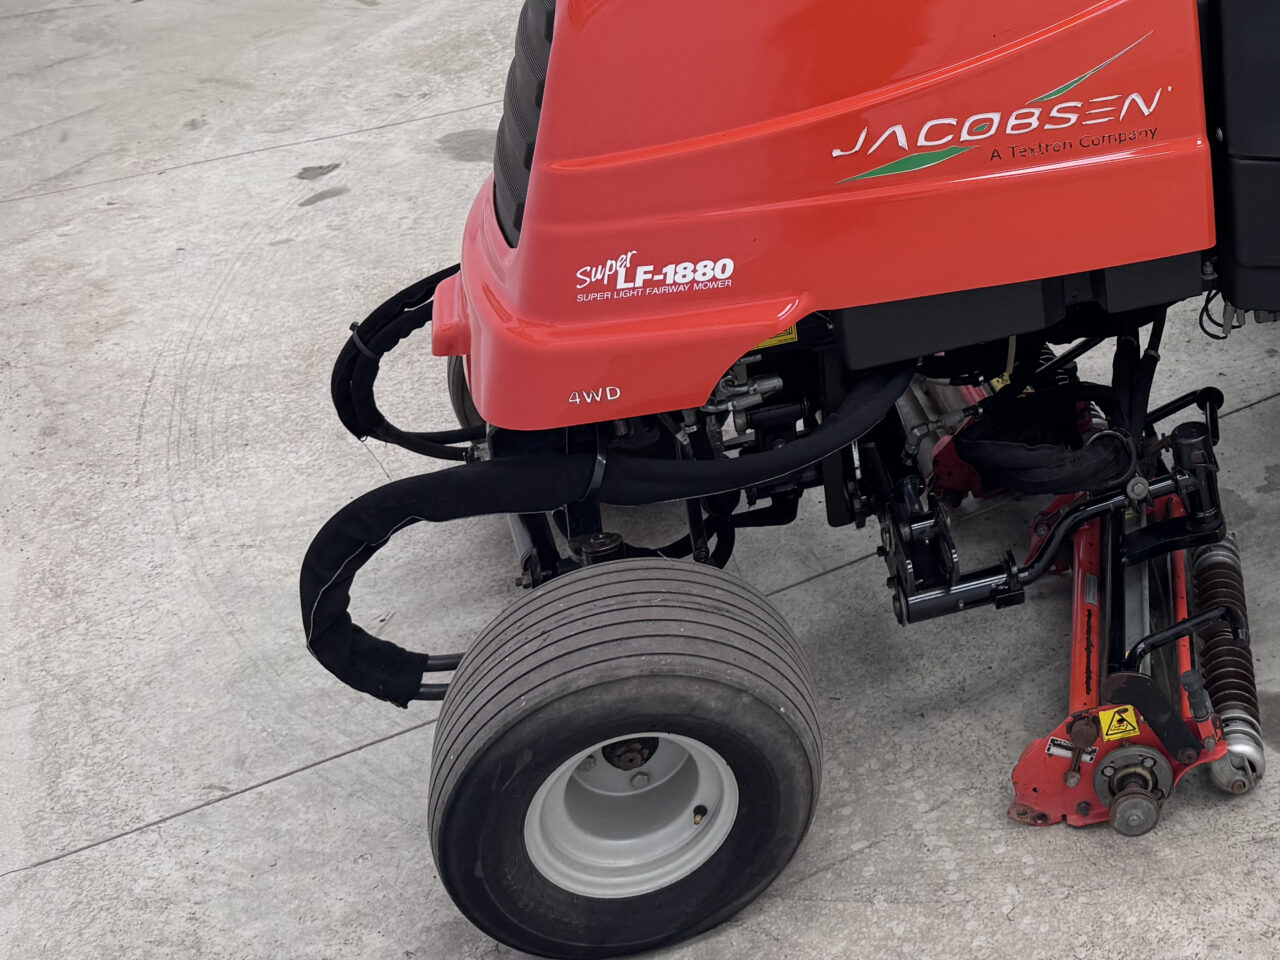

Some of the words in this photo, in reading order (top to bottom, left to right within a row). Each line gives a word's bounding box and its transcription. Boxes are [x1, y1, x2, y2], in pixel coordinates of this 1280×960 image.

[832, 87, 1163, 157] JACOBSEN
[990, 149, 1002, 161] A
[1008, 140, 1073, 158] Textron
[1079, 127, 1158, 148] Company
[576, 250, 638, 289] Super
[616, 257, 735, 289] LF-1880
[576, 291, 612, 303] SUPER
[614, 288, 643, 300] LIGHT
[646, 284, 690, 295] FAIRWAY
[694, 279, 732, 291] MOWER
[568, 386, 621, 406] 4WD
